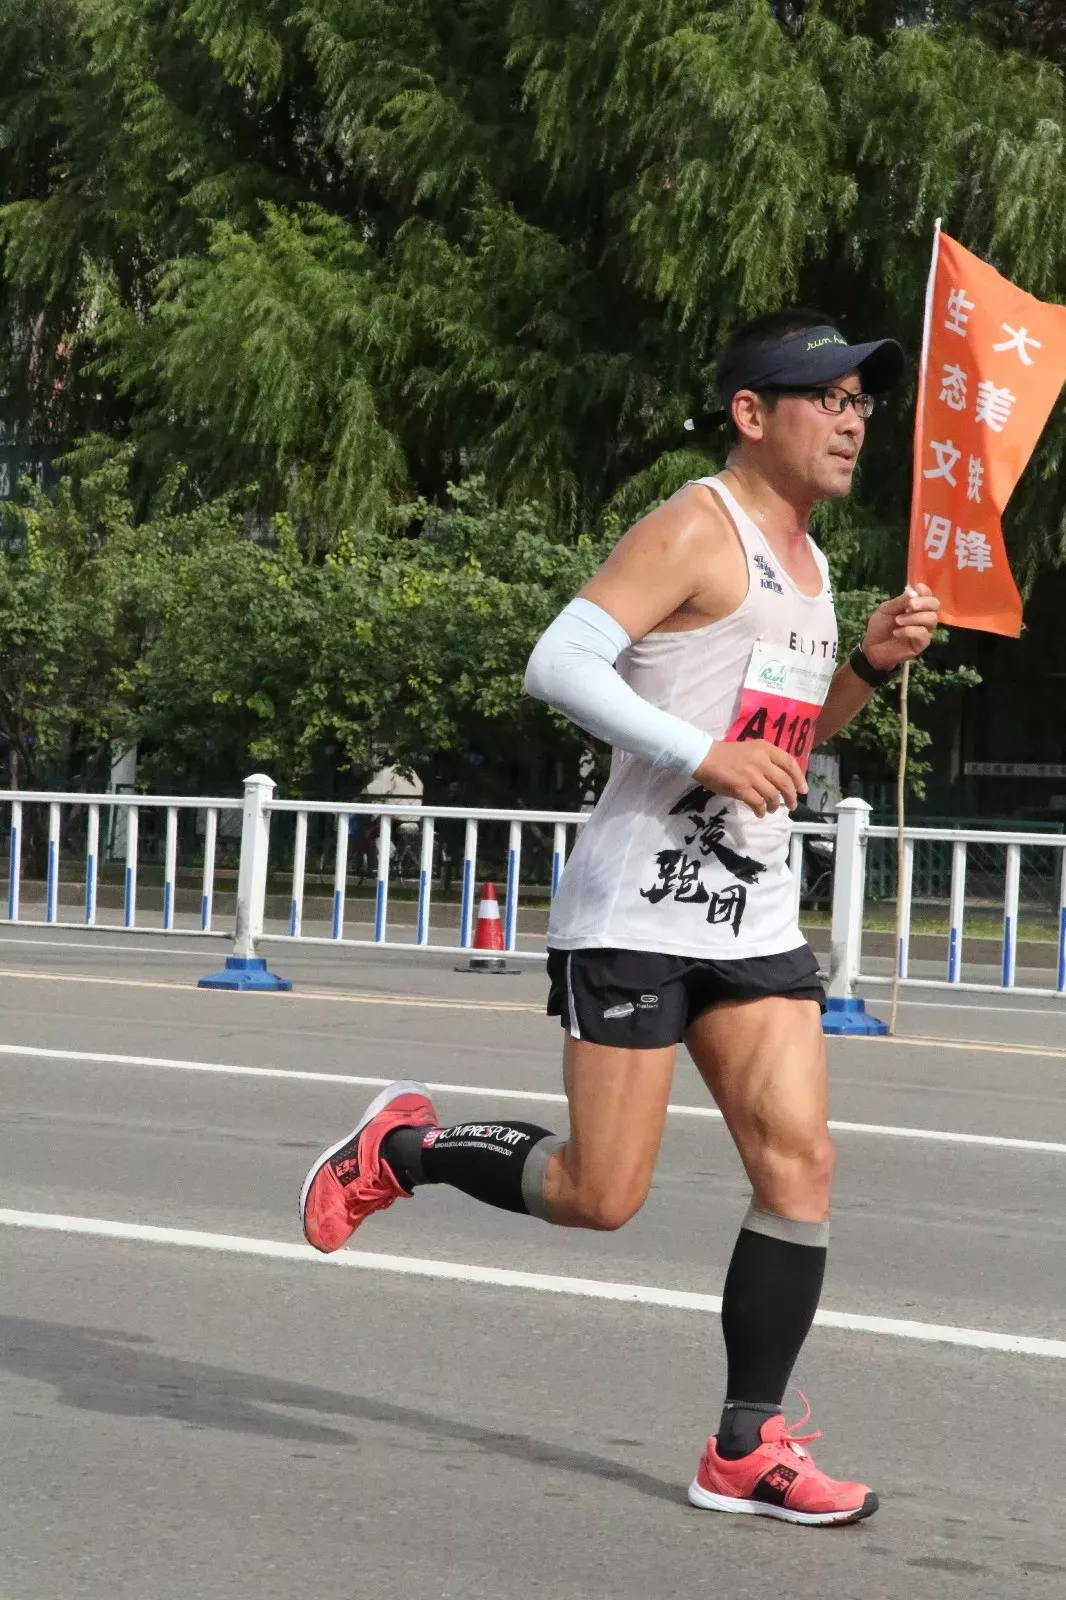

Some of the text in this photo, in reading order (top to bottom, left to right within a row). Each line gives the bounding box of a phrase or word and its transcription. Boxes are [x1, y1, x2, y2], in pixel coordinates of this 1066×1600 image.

[806, 337, 833, 351] run
[923, 288, 976, 561] 生态文明
